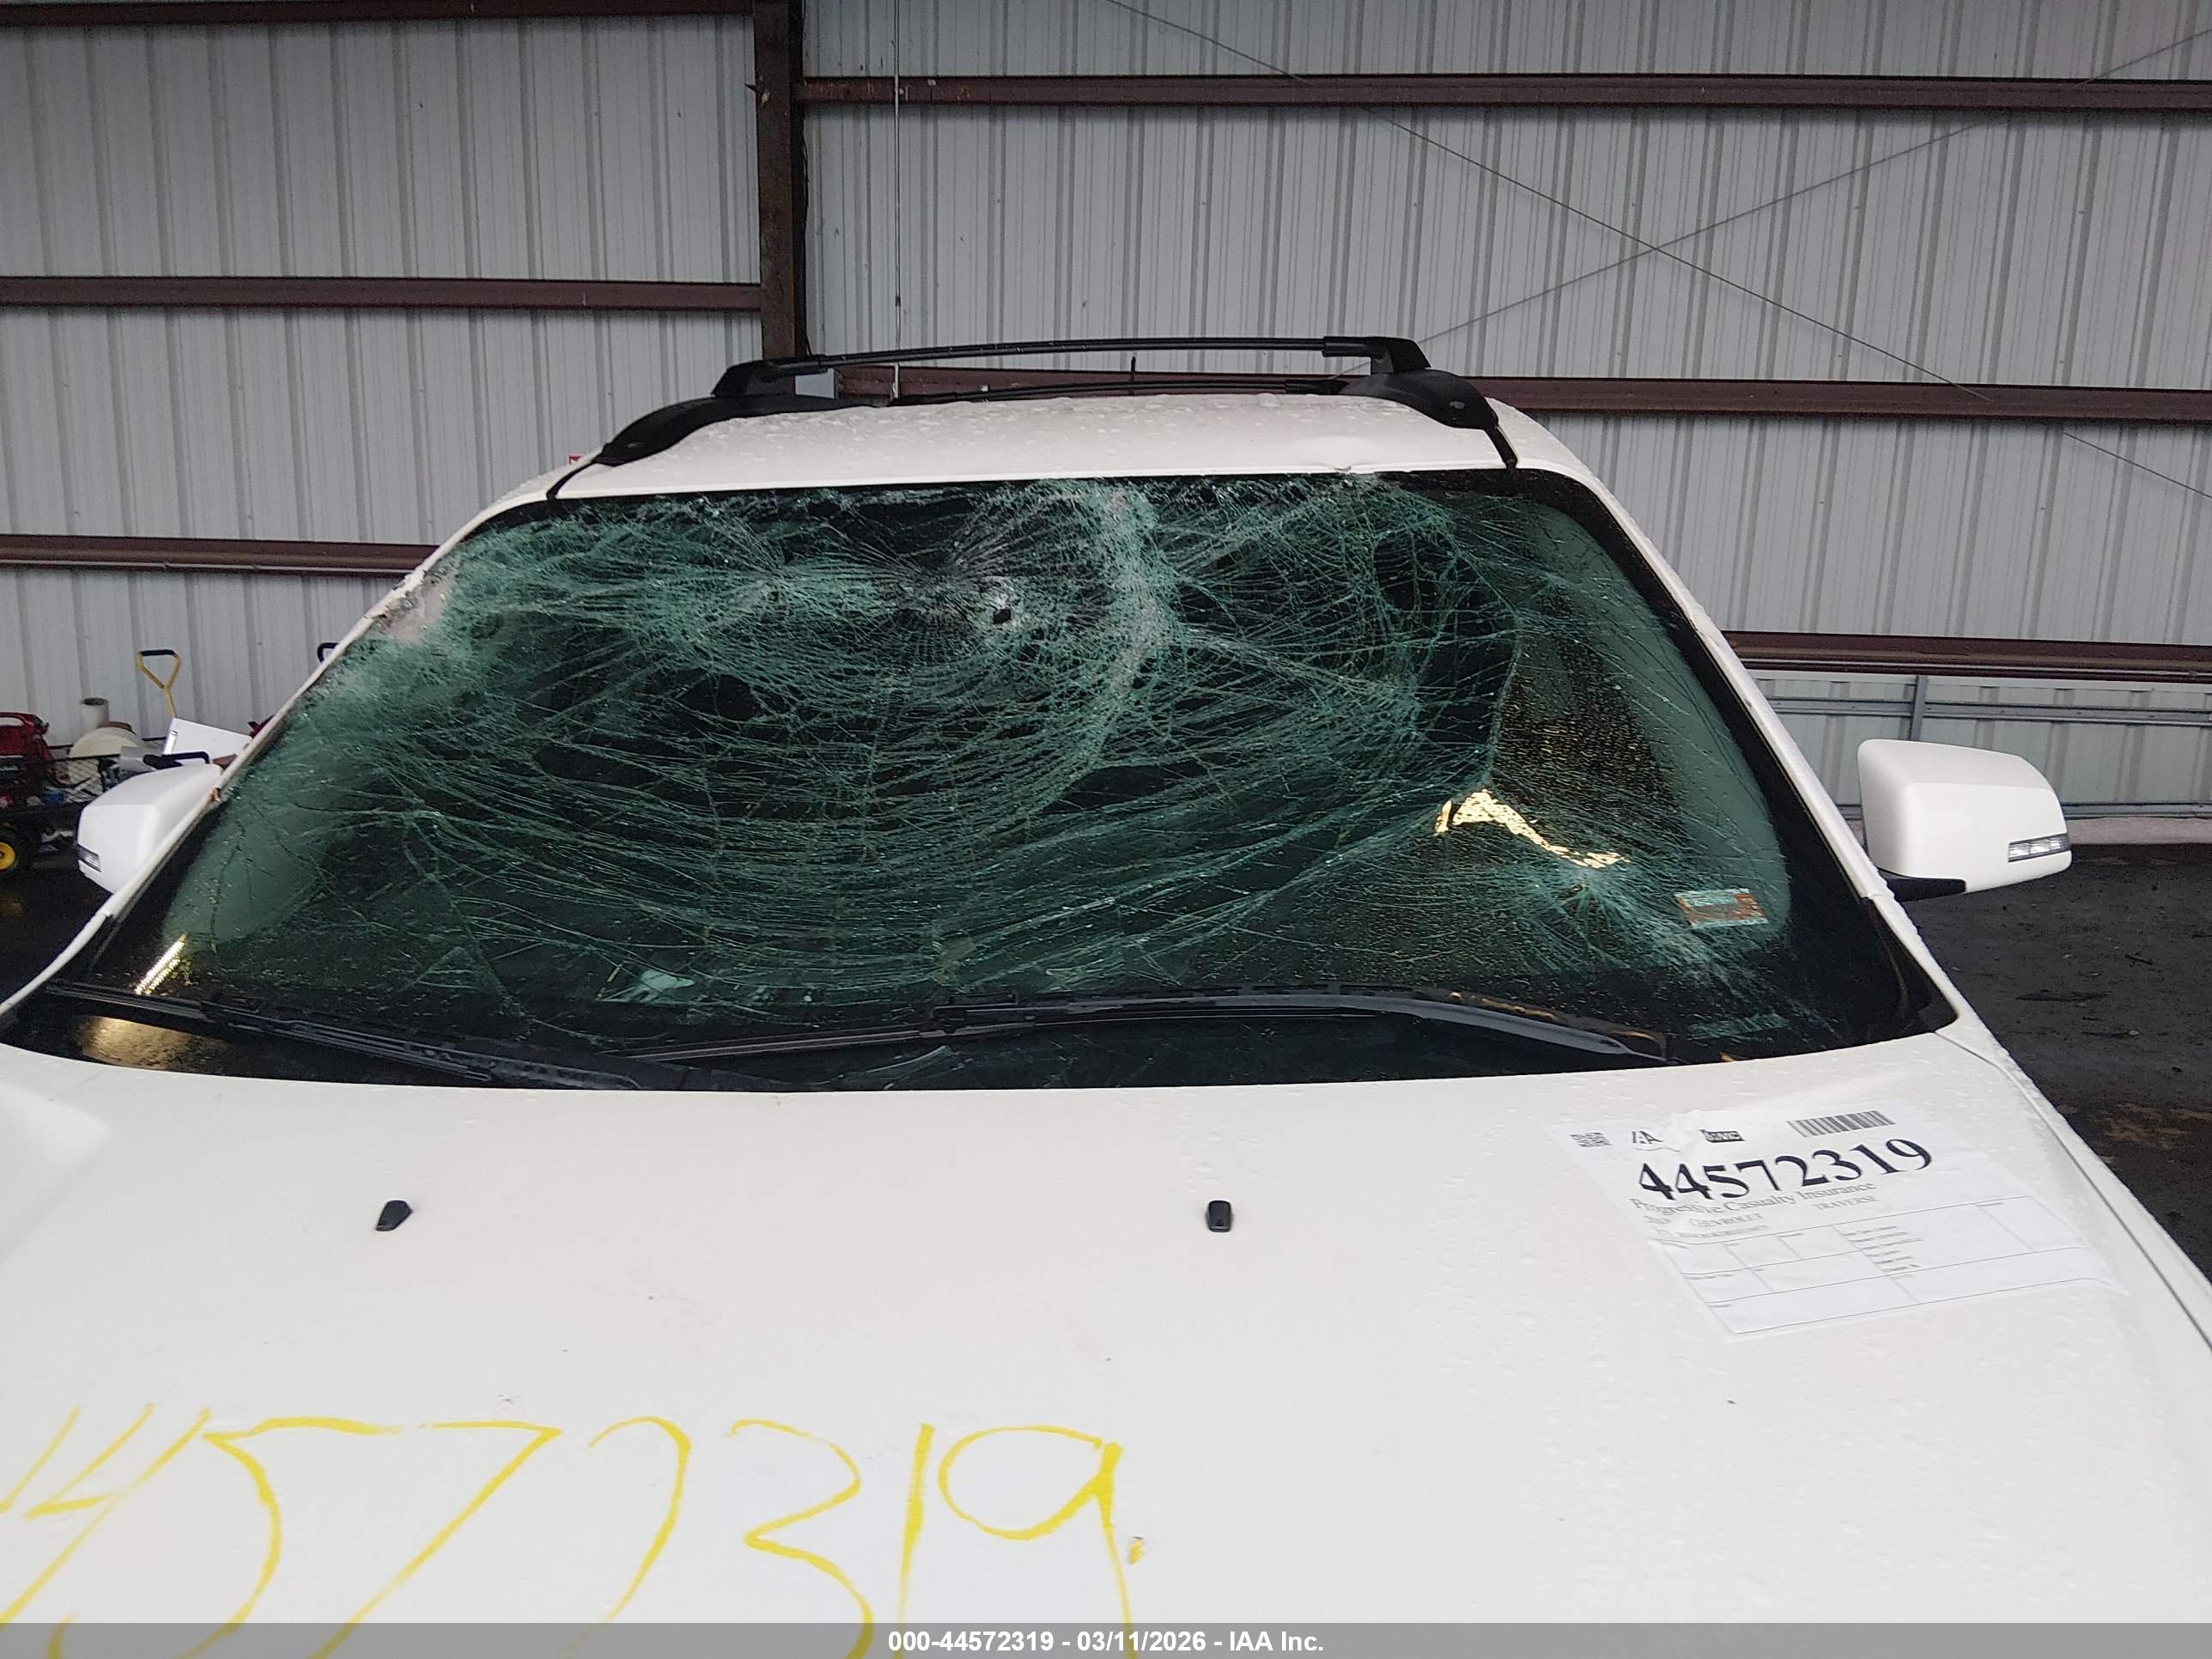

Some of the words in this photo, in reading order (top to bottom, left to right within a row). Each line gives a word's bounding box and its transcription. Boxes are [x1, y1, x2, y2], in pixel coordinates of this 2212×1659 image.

[1638, 1138, 1933, 1200] 44572319
[1723, 1190, 1796, 1212] Casualty
[1796, 1182, 1877, 1204] Insurance
